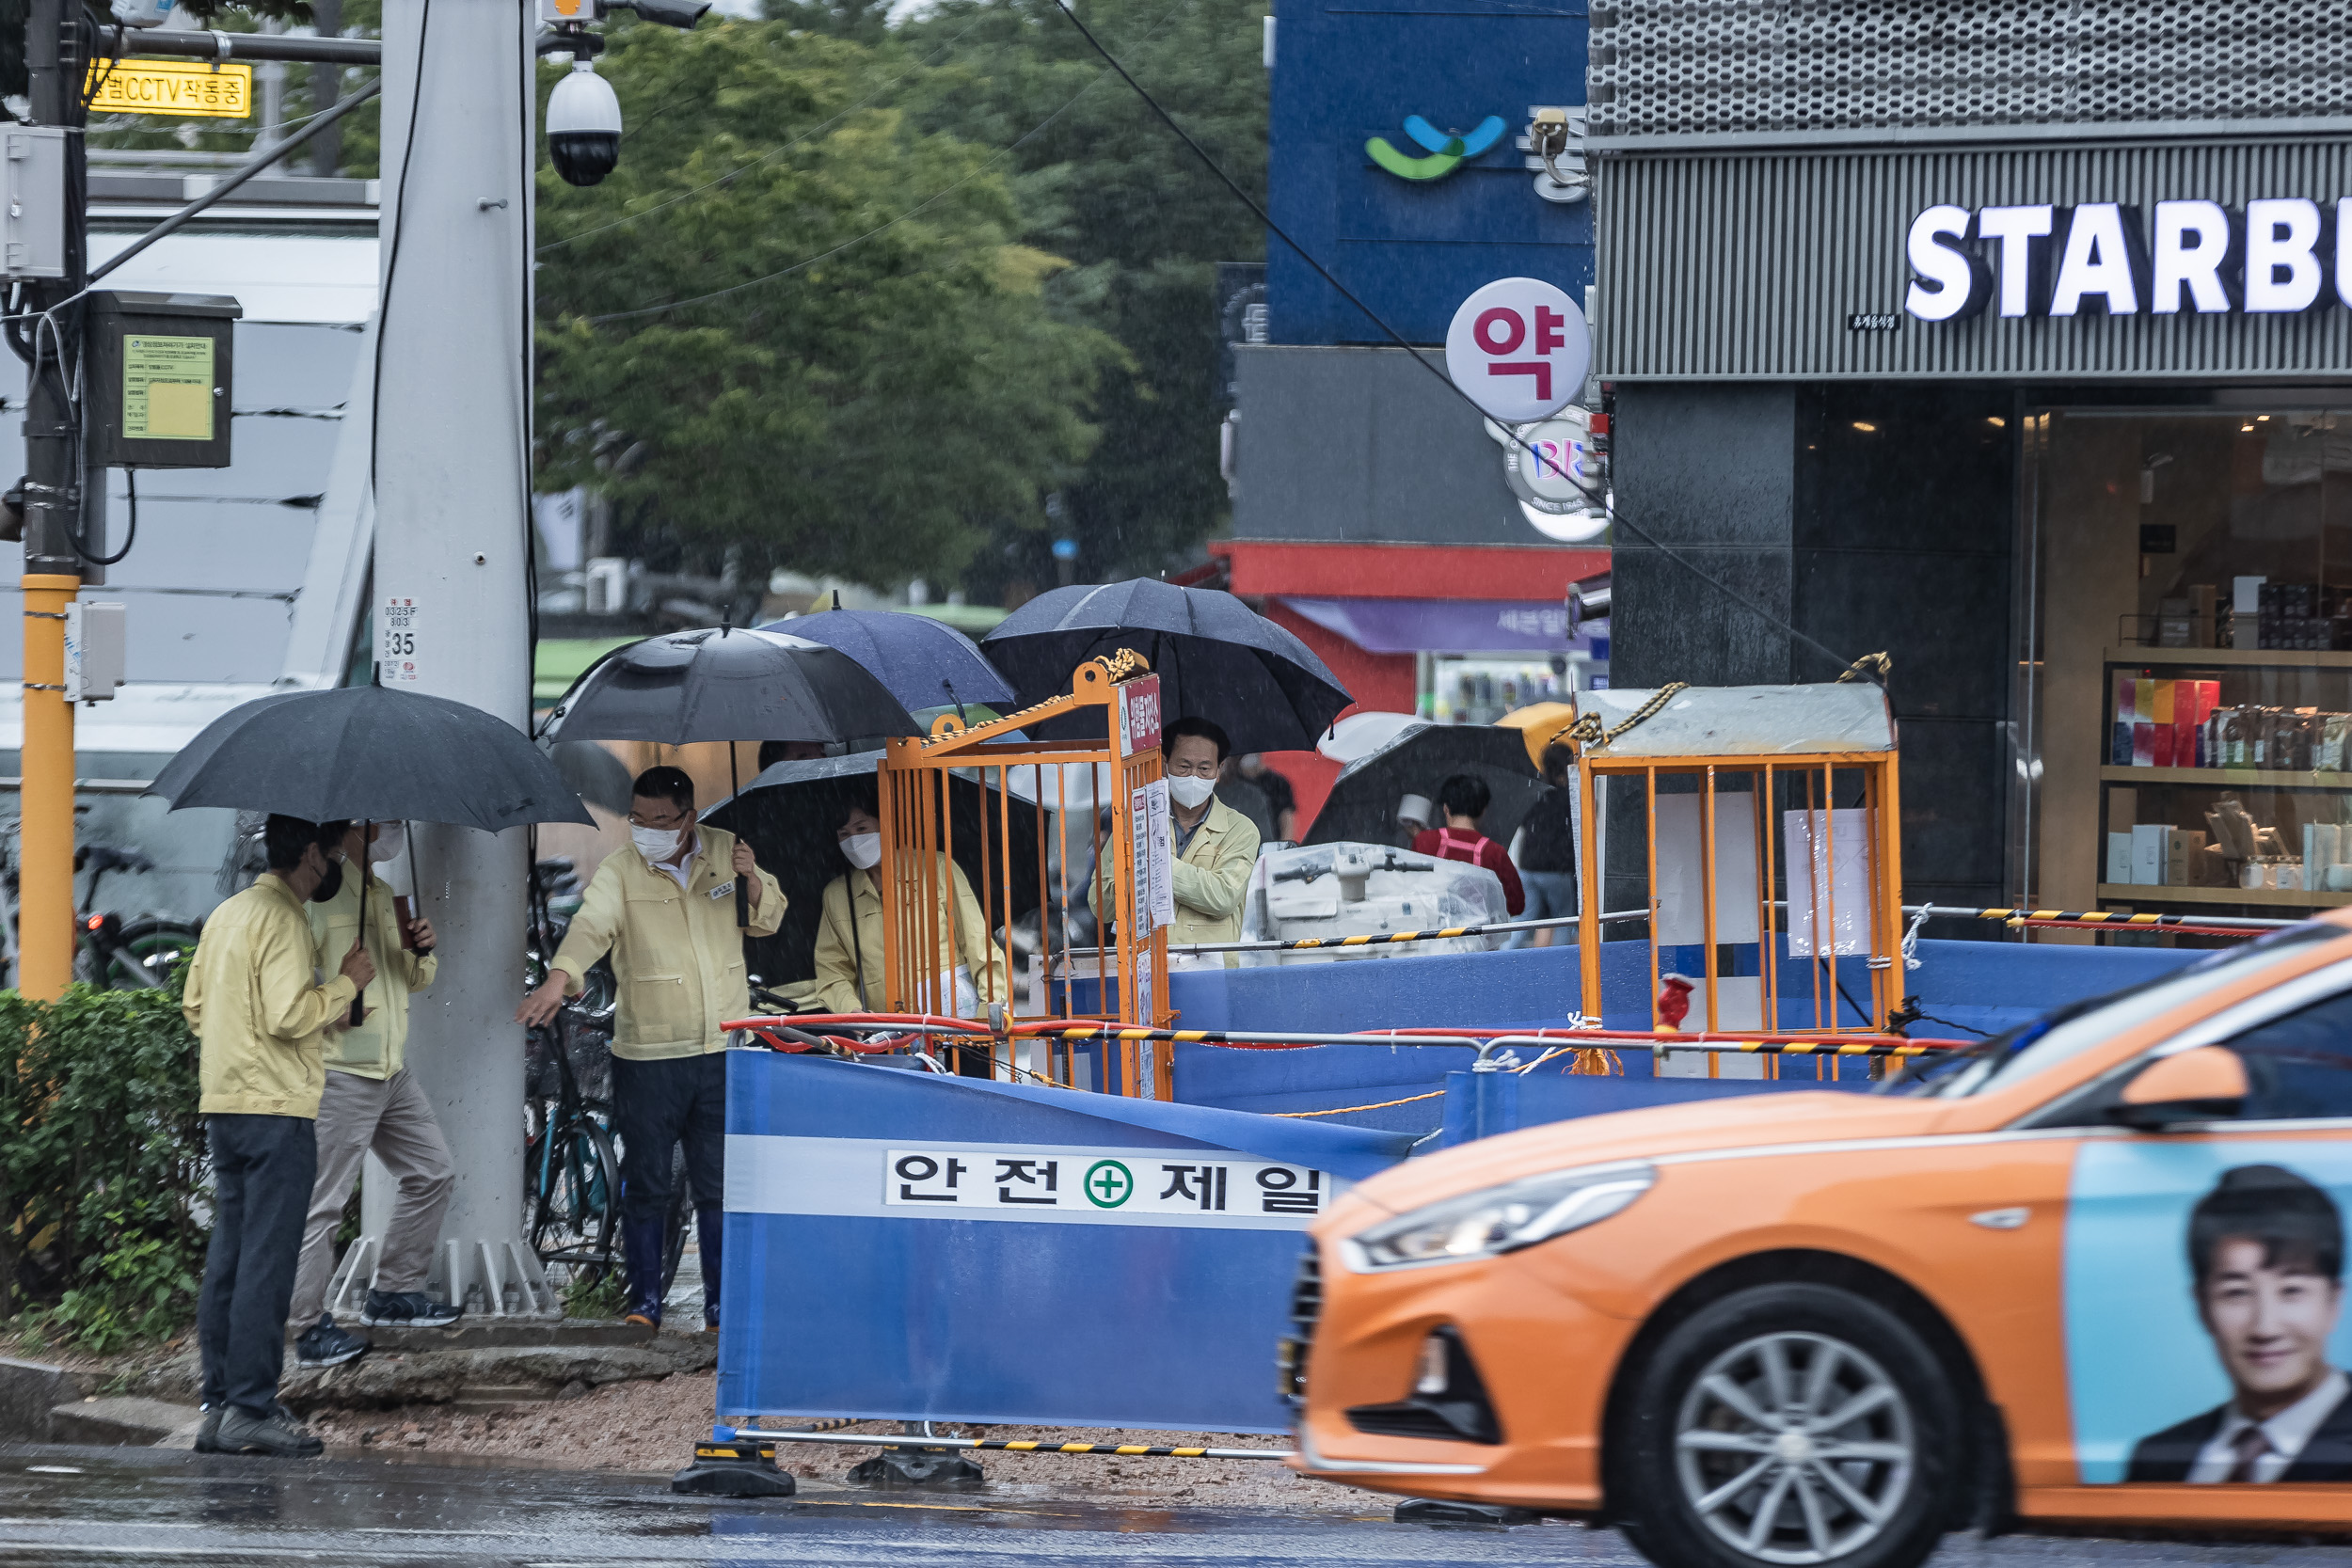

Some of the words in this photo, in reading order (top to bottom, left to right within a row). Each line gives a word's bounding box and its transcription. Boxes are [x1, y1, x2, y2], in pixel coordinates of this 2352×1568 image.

[1904, 197, 2352, 322] STARB
[1473, 306, 1565, 400] 약
[1507, 453, 1518, 472] THE
[1528, 438, 1585, 480] BR
[1531, 497, 1561, 512] SINCE
[391, 632, 414, 656] 35
[1130, 692, 1159, 739] 위험물저장소
[895, 1154, 1057, 1205] 안전
